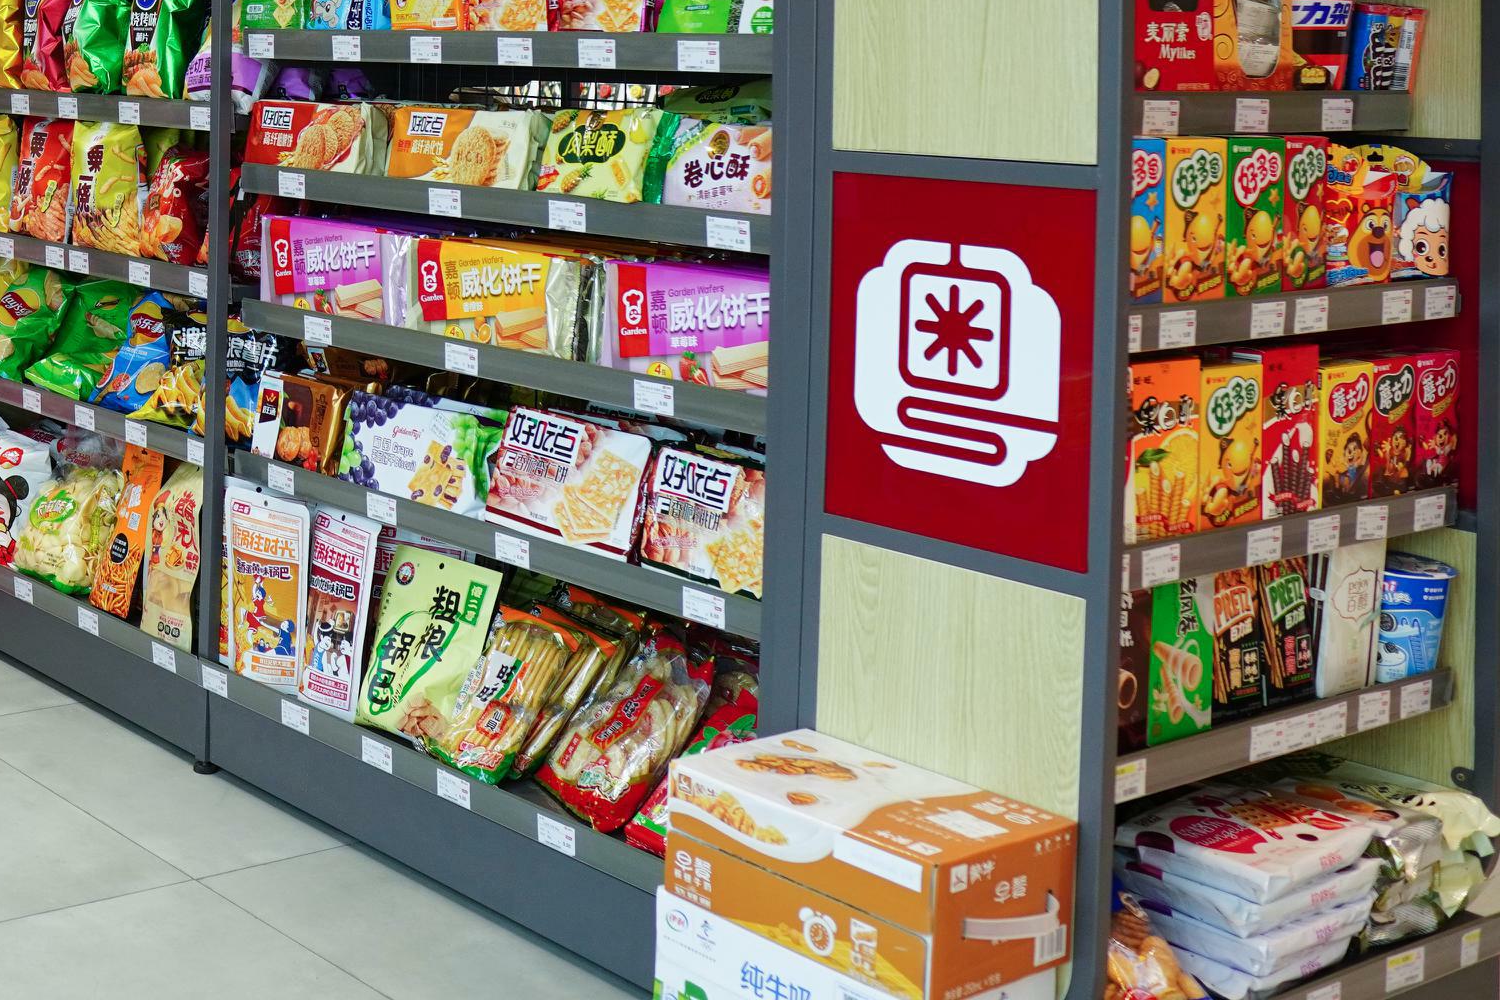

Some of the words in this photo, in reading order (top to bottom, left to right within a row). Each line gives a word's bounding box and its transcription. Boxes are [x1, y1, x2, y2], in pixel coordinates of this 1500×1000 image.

[131, 10, 158, 29] 烧烤味
[1145, 22, 1190, 42] 麦丽素
[1159, 43, 1196, 62] Mylikes
[262, 108, 293, 128] 好吃点
[410, 113, 445, 134] 好吃点
[683, 153, 751, 188] 卷心酥
[1175, 152, 1221, 204] 好多鱼
[1237, 150, 1281, 204] 好多鱼
[1291, 146, 1325, 198] 好多鱼
[293, 239, 306, 275] 嘉顿
[304, 236, 324, 246] Garden
[324, 233, 343, 244] Wafers
[306, 240, 377, 274] 威化饼干
[275, 270, 292, 278] Garden
[458, 258, 481, 268] Garden
[481, 254, 505, 265] Wafers
[420, 293, 444, 303] Garden
[445, 260, 462, 300] 嘉顿
[461, 263, 542, 299] 威化饼干
[668, 286, 696, 298] Garden
[696, 283, 725, 296] Wafers
[650, 289, 668, 335] 嘉顿
[668, 291, 770, 334] 威化饼干
[620, 326, 648, 336] Garden
[1332, 376, 1369, 417] 蘑古力
[1377, 370, 1414, 412] 蘑古力
[1421, 367, 1456, 405] 蘑古力
[1211, 381, 1256, 429] 好多鱼
[510, 413, 579, 453] 好吃点
[661, 455, 733, 501] 好吃点
[1213, 588, 1254, 628] PRETZ
[1268, 577, 1306, 617] PRETZ
[415, 584, 462, 662] 粗粮
